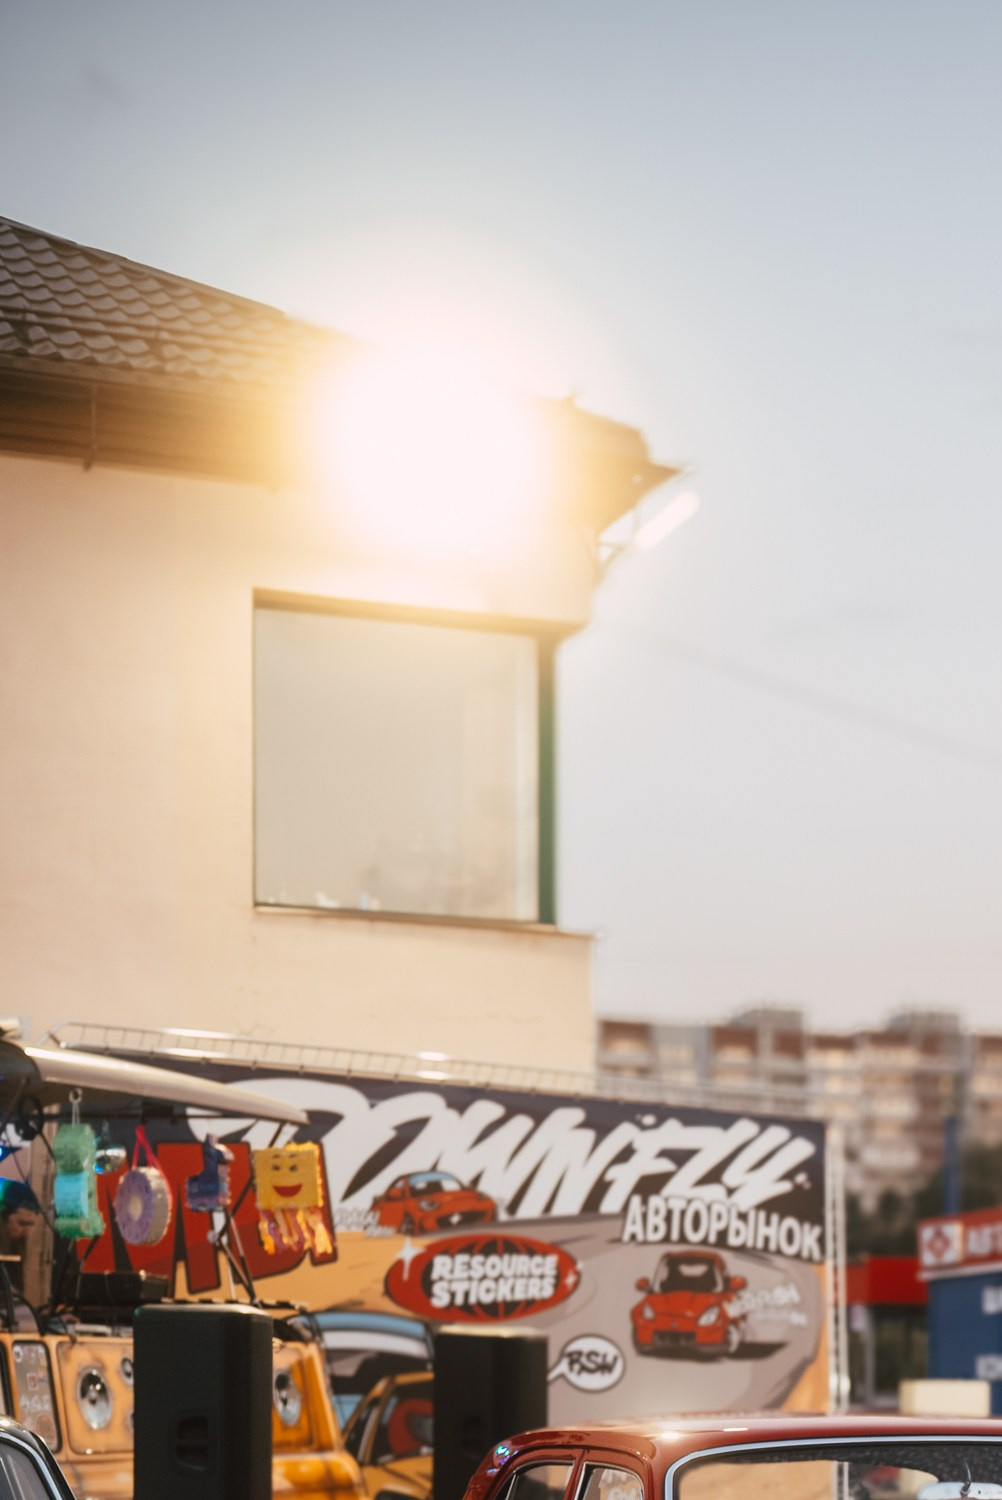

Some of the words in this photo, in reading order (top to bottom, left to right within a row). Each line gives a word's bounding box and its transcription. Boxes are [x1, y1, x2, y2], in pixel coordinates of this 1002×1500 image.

[622, 1194, 823, 1261] АВТОРЫНОК
[430, 1253, 558, 1280] RESOURCE
[430, 1277, 555, 1308] STICKERS
